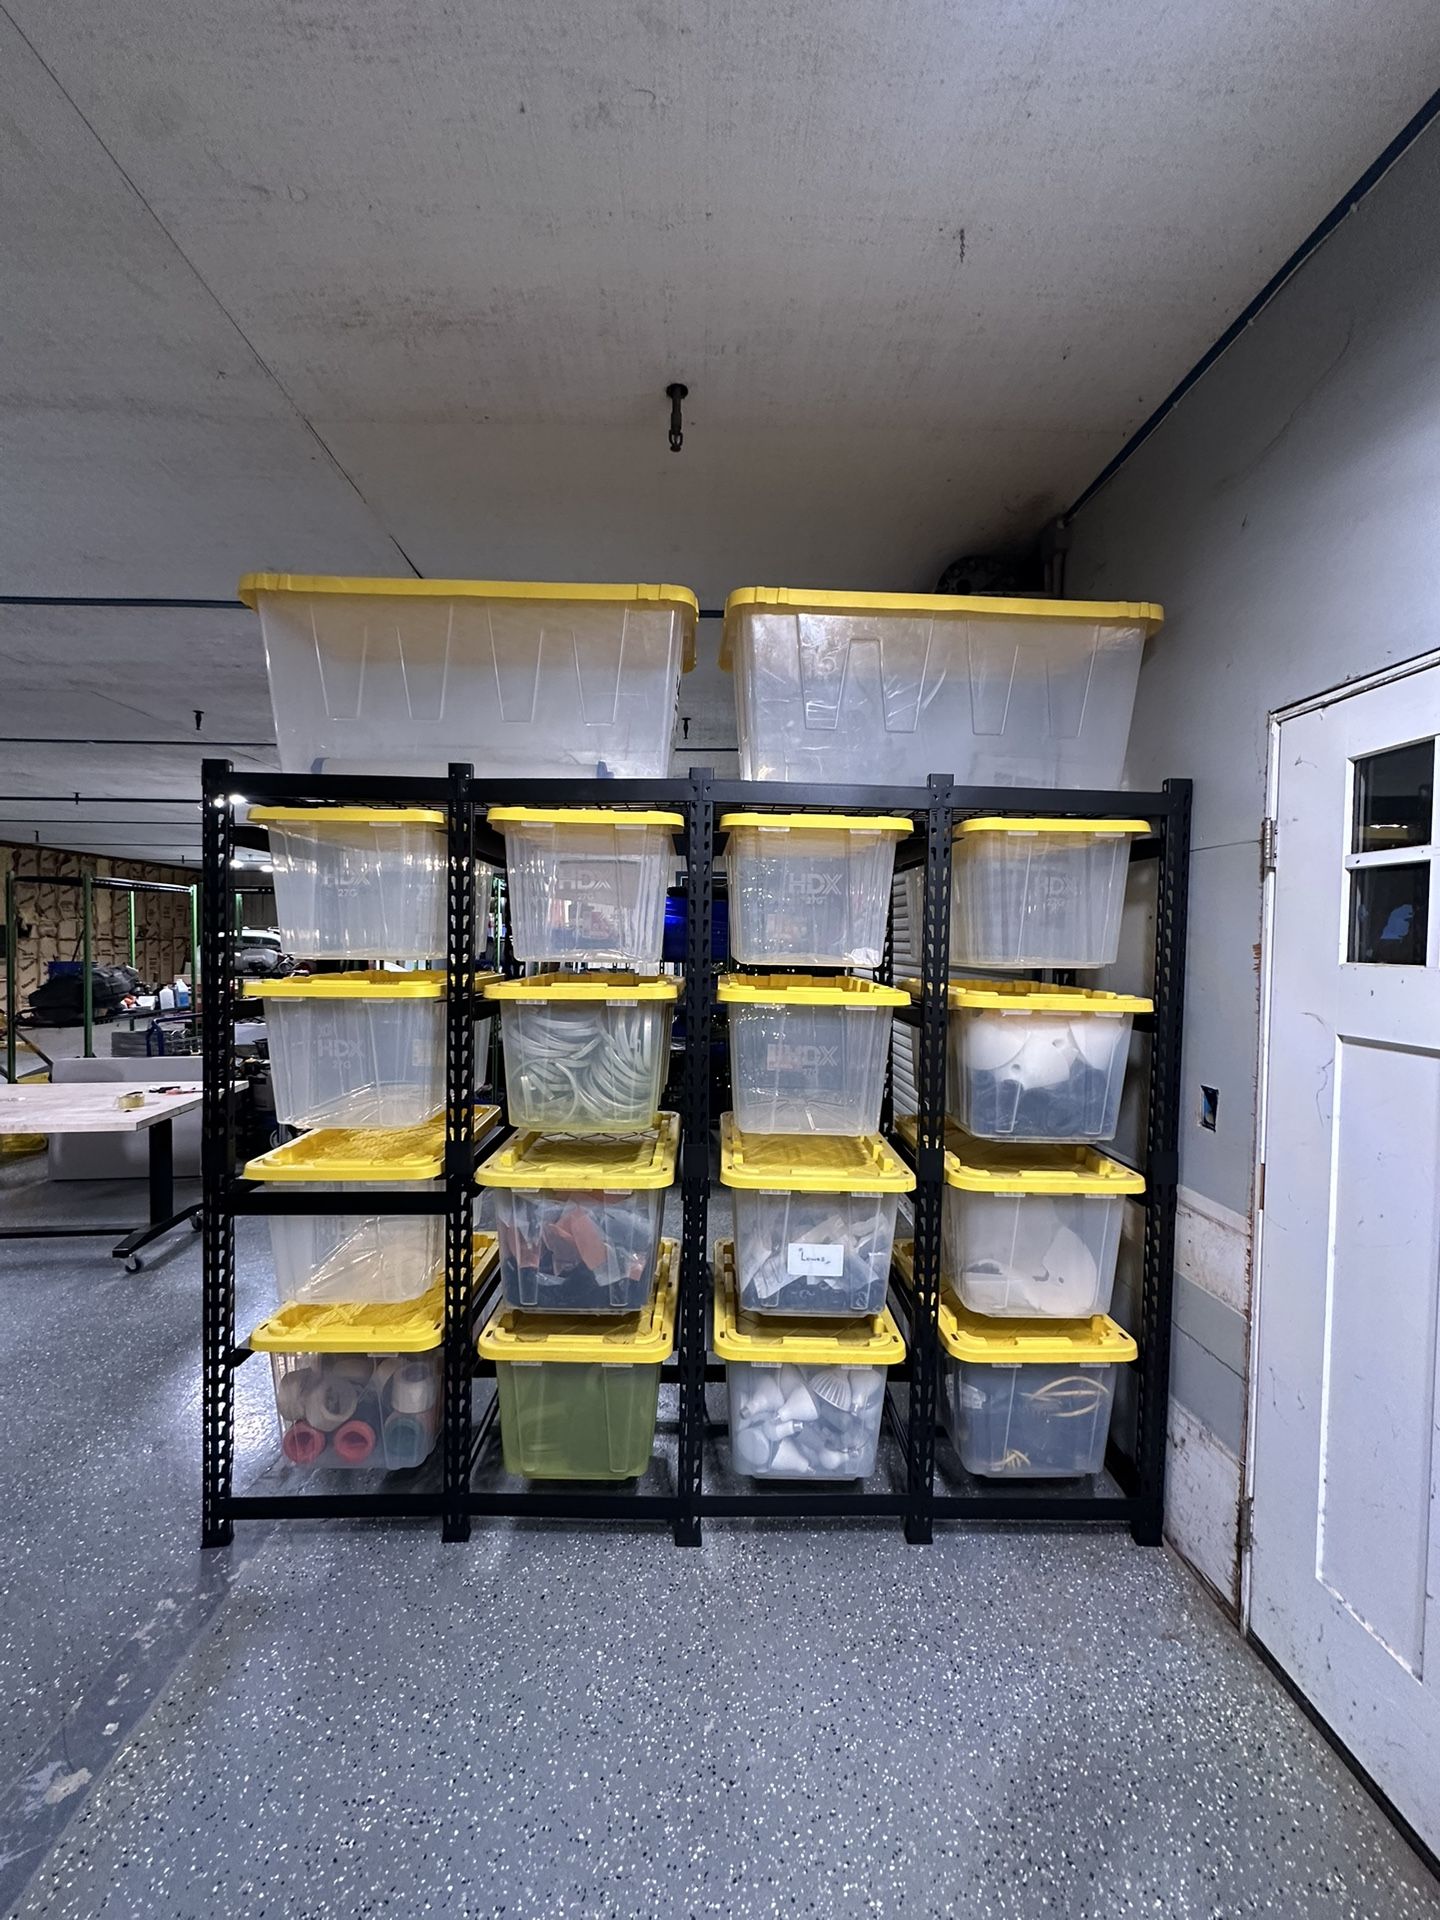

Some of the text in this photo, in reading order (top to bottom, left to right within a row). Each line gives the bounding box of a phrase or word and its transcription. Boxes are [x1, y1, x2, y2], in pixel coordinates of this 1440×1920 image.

[323, 868, 370, 886] HDX
[559, 869, 611, 889] HDX
[788, 873, 843, 895] HDX
[1034, 876, 1078, 896] HDX
[337, 889, 358, 897] 27G
[317, 1039, 364, 1058] HDX
